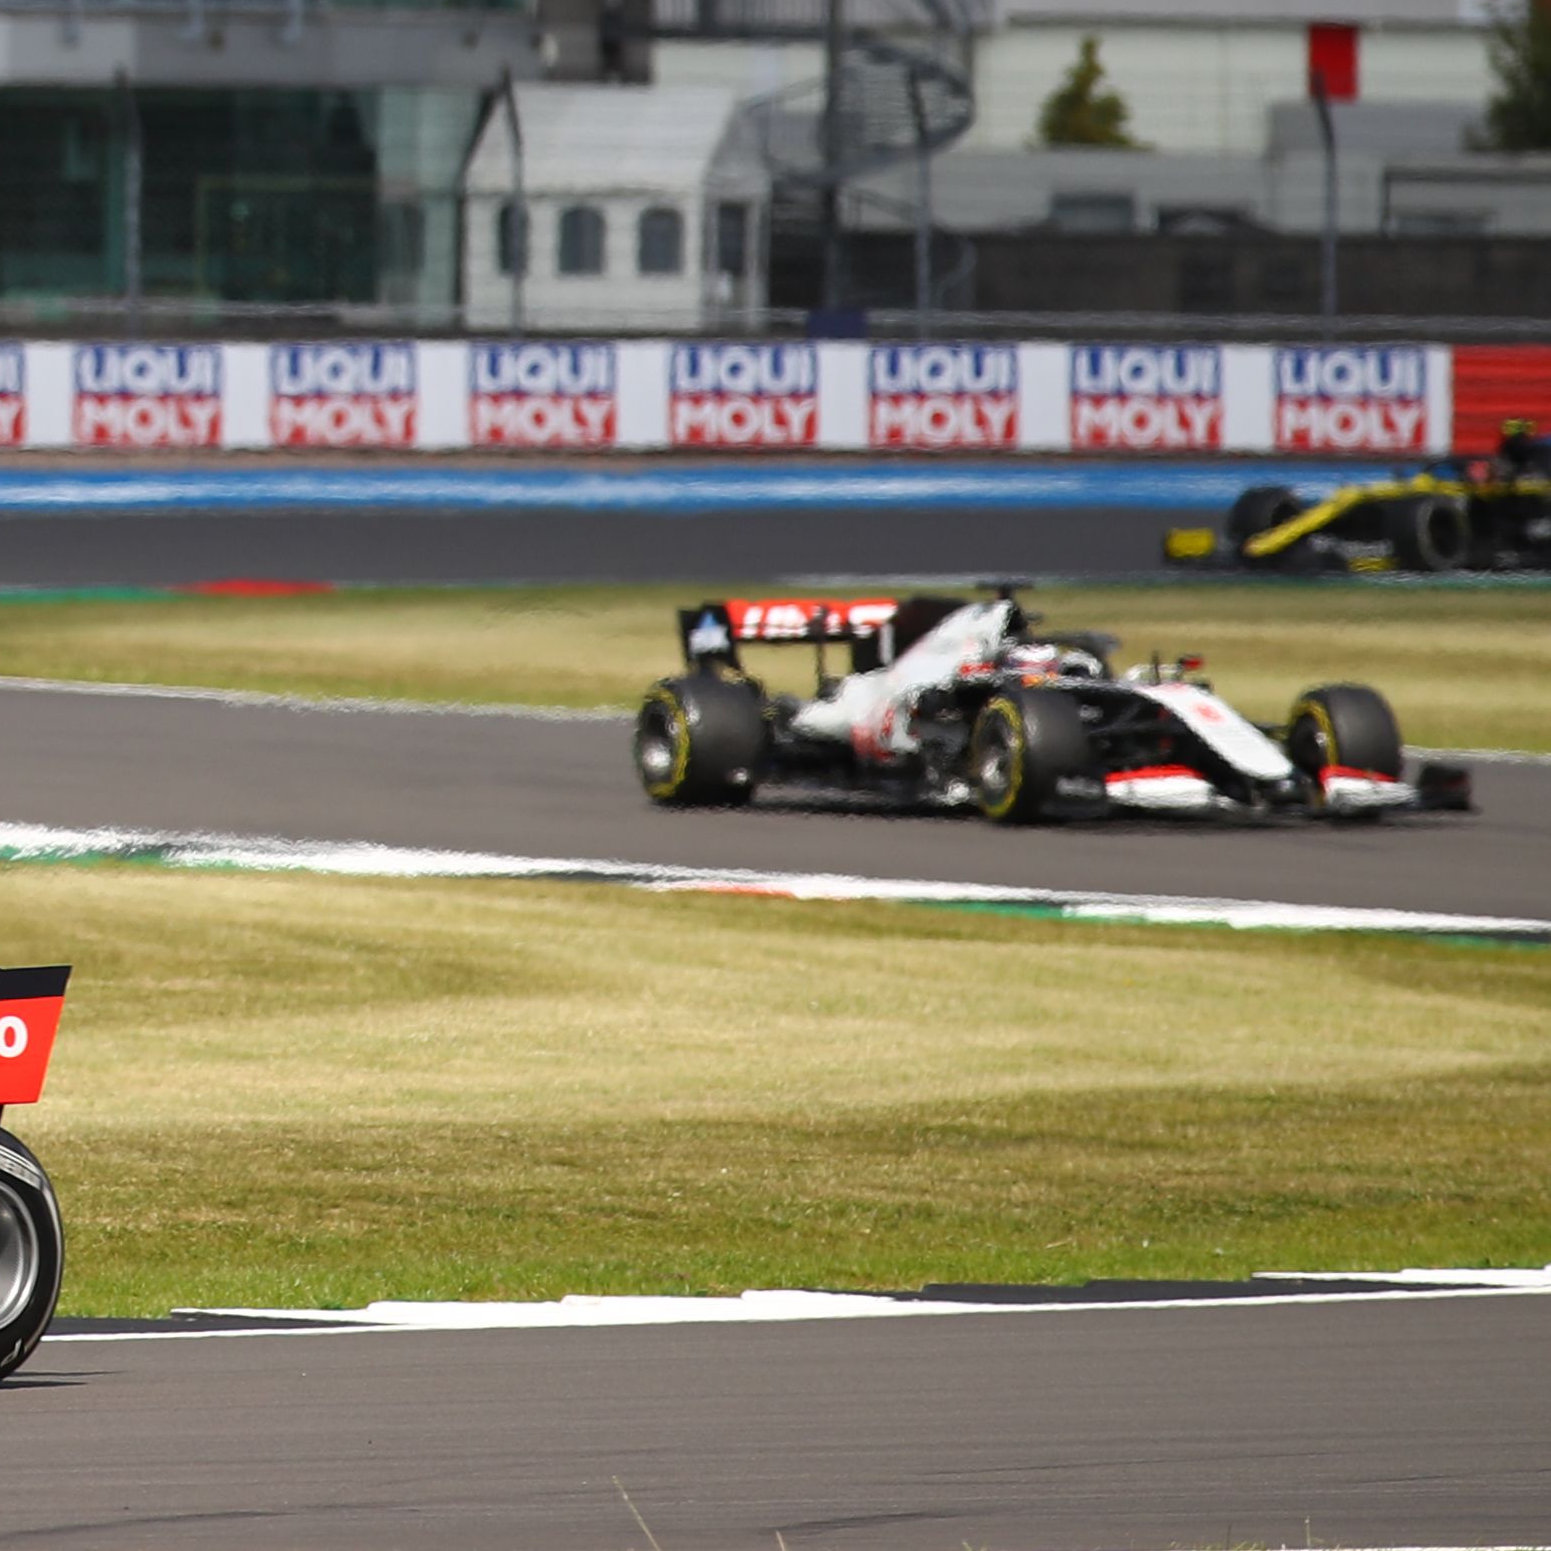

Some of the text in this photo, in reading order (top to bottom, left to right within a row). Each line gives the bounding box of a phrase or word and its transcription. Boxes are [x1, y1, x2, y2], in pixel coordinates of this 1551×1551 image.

[82, 398, 221, 445] MOLY
[277, 399, 416, 446] MOLY
[477, 398, 617, 446] MOLY
[676, 398, 818, 446] MOLY
[876, 398, 1018, 446] MOLY
[1077, 400, 1221, 449] MOLY
[1282, 402, 1427, 451] MOLY
